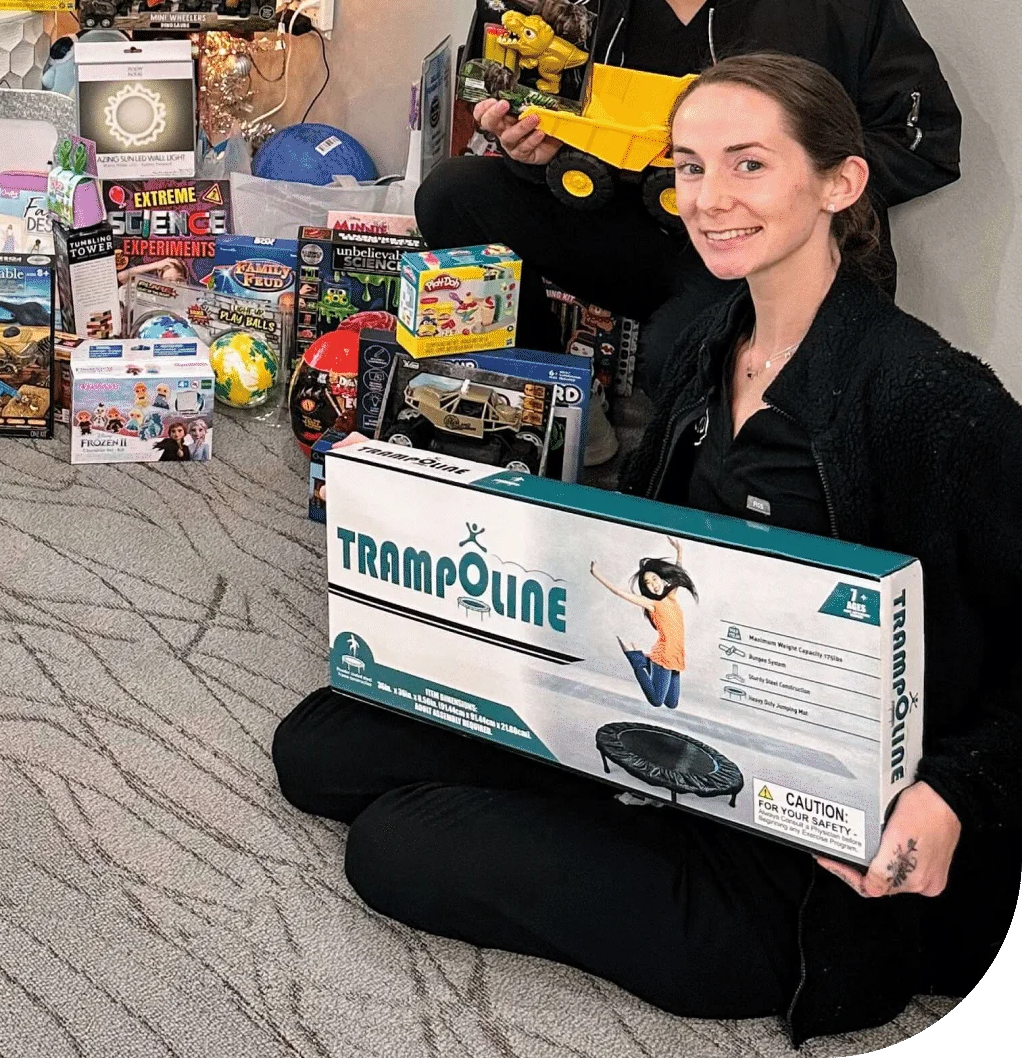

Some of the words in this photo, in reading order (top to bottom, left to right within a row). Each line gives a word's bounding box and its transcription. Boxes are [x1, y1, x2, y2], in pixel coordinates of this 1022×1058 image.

[150, 13, 167, 22] MINI
[169, 13, 207, 22] WHEELERS
[97, 155, 119, 163] AZING
[135, 154, 147, 162] LED
[166, 153, 186, 161] LIGHT
[134, 187, 197, 208] EXTREME
[107, 209, 227, 238] SCIENCE
[69, 235, 113, 248] TUMBLING
[69, 242, 114, 258] TOWER
[123, 239, 216, 258] EXPERIMENTS
[235, 260, 293, 279] FAMILY
[243, 273, 284, 288] FEUD
[220, 310, 243, 325] PLAY
[245, 317, 276, 332] BALLS
[80, 438, 119, 448] FROZEN
[120, 439, 127, 447] II
[358, 446, 470, 475] TRAMPOLINE
[337, 526, 567, 634] TRAMPOLINE
[748, 634, 777, 646] Maximum
[777, 641, 798, 652] Weight
[890, 588, 910, 785] TRAMPOLINE
[758, 799, 779, 813] FOR
[780, 806, 809, 822] YOUR
[811, 816, 851, 836] SAFETY
[786, 792, 849, 823] CAUTION:
[758, 809, 780, 821] Always
[780, 815, 804, 828] Consult
[810, 825, 841, 840] Physician
[841, 835, 862, 847] before
[758, 815, 788, 831] Beginning
[789, 826, 801, 835] any
[802, 829, 828, 843] Exercise
